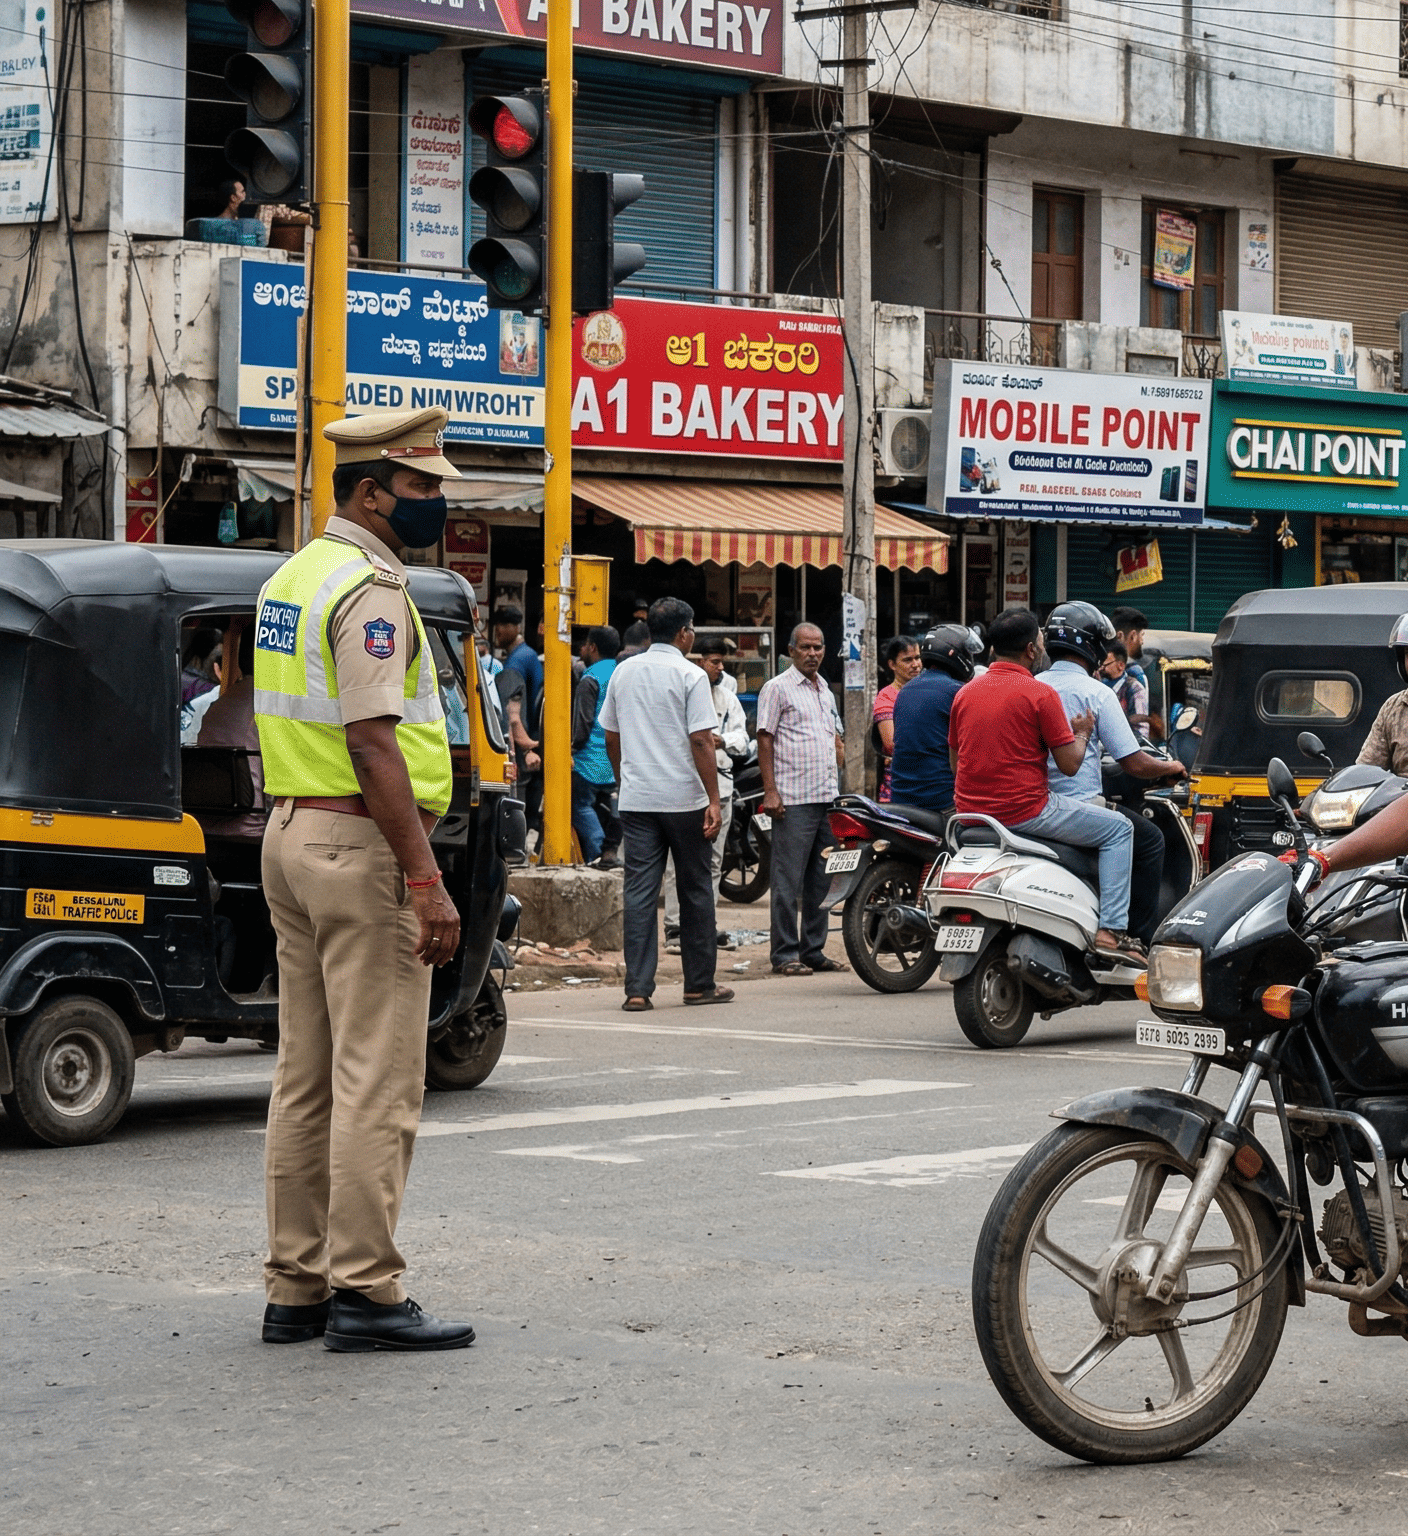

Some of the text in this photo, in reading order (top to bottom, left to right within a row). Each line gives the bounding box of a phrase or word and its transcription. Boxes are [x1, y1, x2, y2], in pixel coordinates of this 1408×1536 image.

[602, 0, 771, 56] BAKERY
[411, 387, 535, 417] NIMWROHT
[571, 376, 844, 446] A1 BAKERY
[959, 397, 1201, 452] MOBILE POINT
[1228, 427, 1406, 477] CHAI POINT
